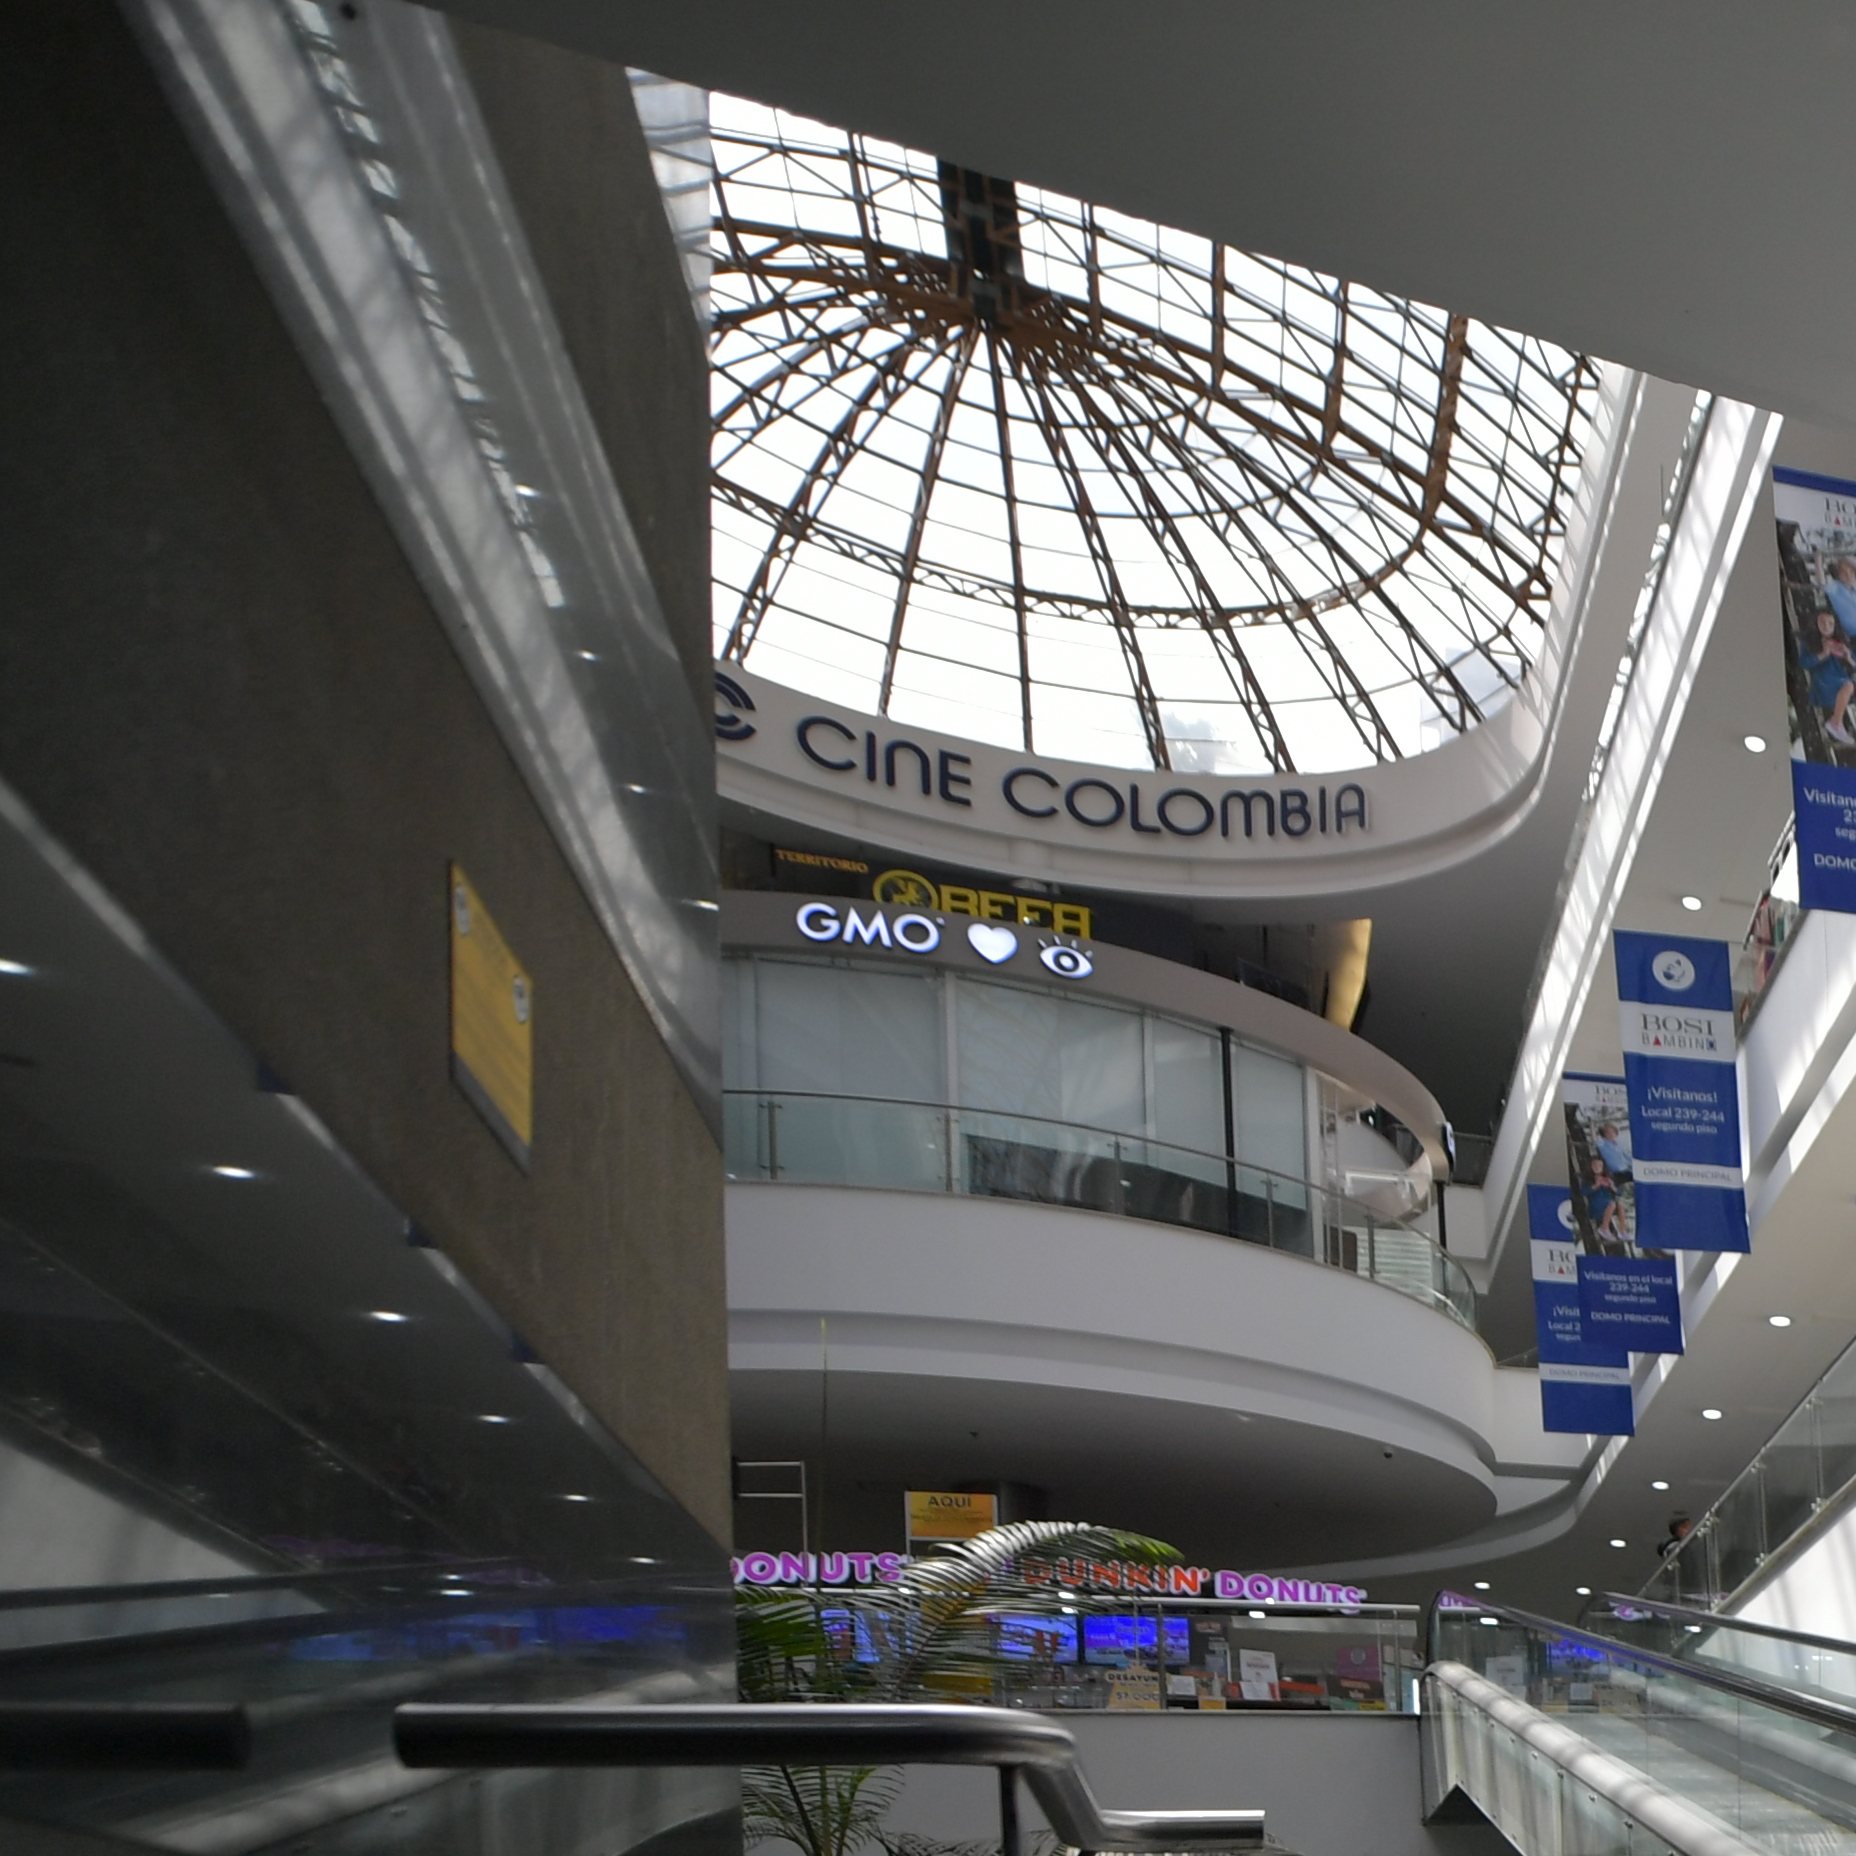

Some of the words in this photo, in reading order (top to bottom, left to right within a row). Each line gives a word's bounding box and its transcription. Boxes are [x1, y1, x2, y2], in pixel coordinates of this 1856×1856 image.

[796, 714, 972, 807] CINE
[1001, 765, 1370, 838] COLOMBIA
[775, 848, 869, 874] TERRITORIO
[796, 901, 941, 954] GMO
[1641, 1014, 1714, 1036] BOSI
[1641, 1105, 1672, 1120] Local
[1674, 1107, 1726, 1123] 239-244
[1650, 1120, 1693, 1135] segundo
[1695, 1122, 1718, 1135] piso
[1643, 1166, 1678, 1179] DOMO
[1680, 1167, 1733, 1182] PRINCIPAL
[1591, 1311, 1622, 1321] DOMO
[1624, 1313, 1670, 1325] PRINCIPAL
[1215, 1567, 1370, 1614] DONUTS
